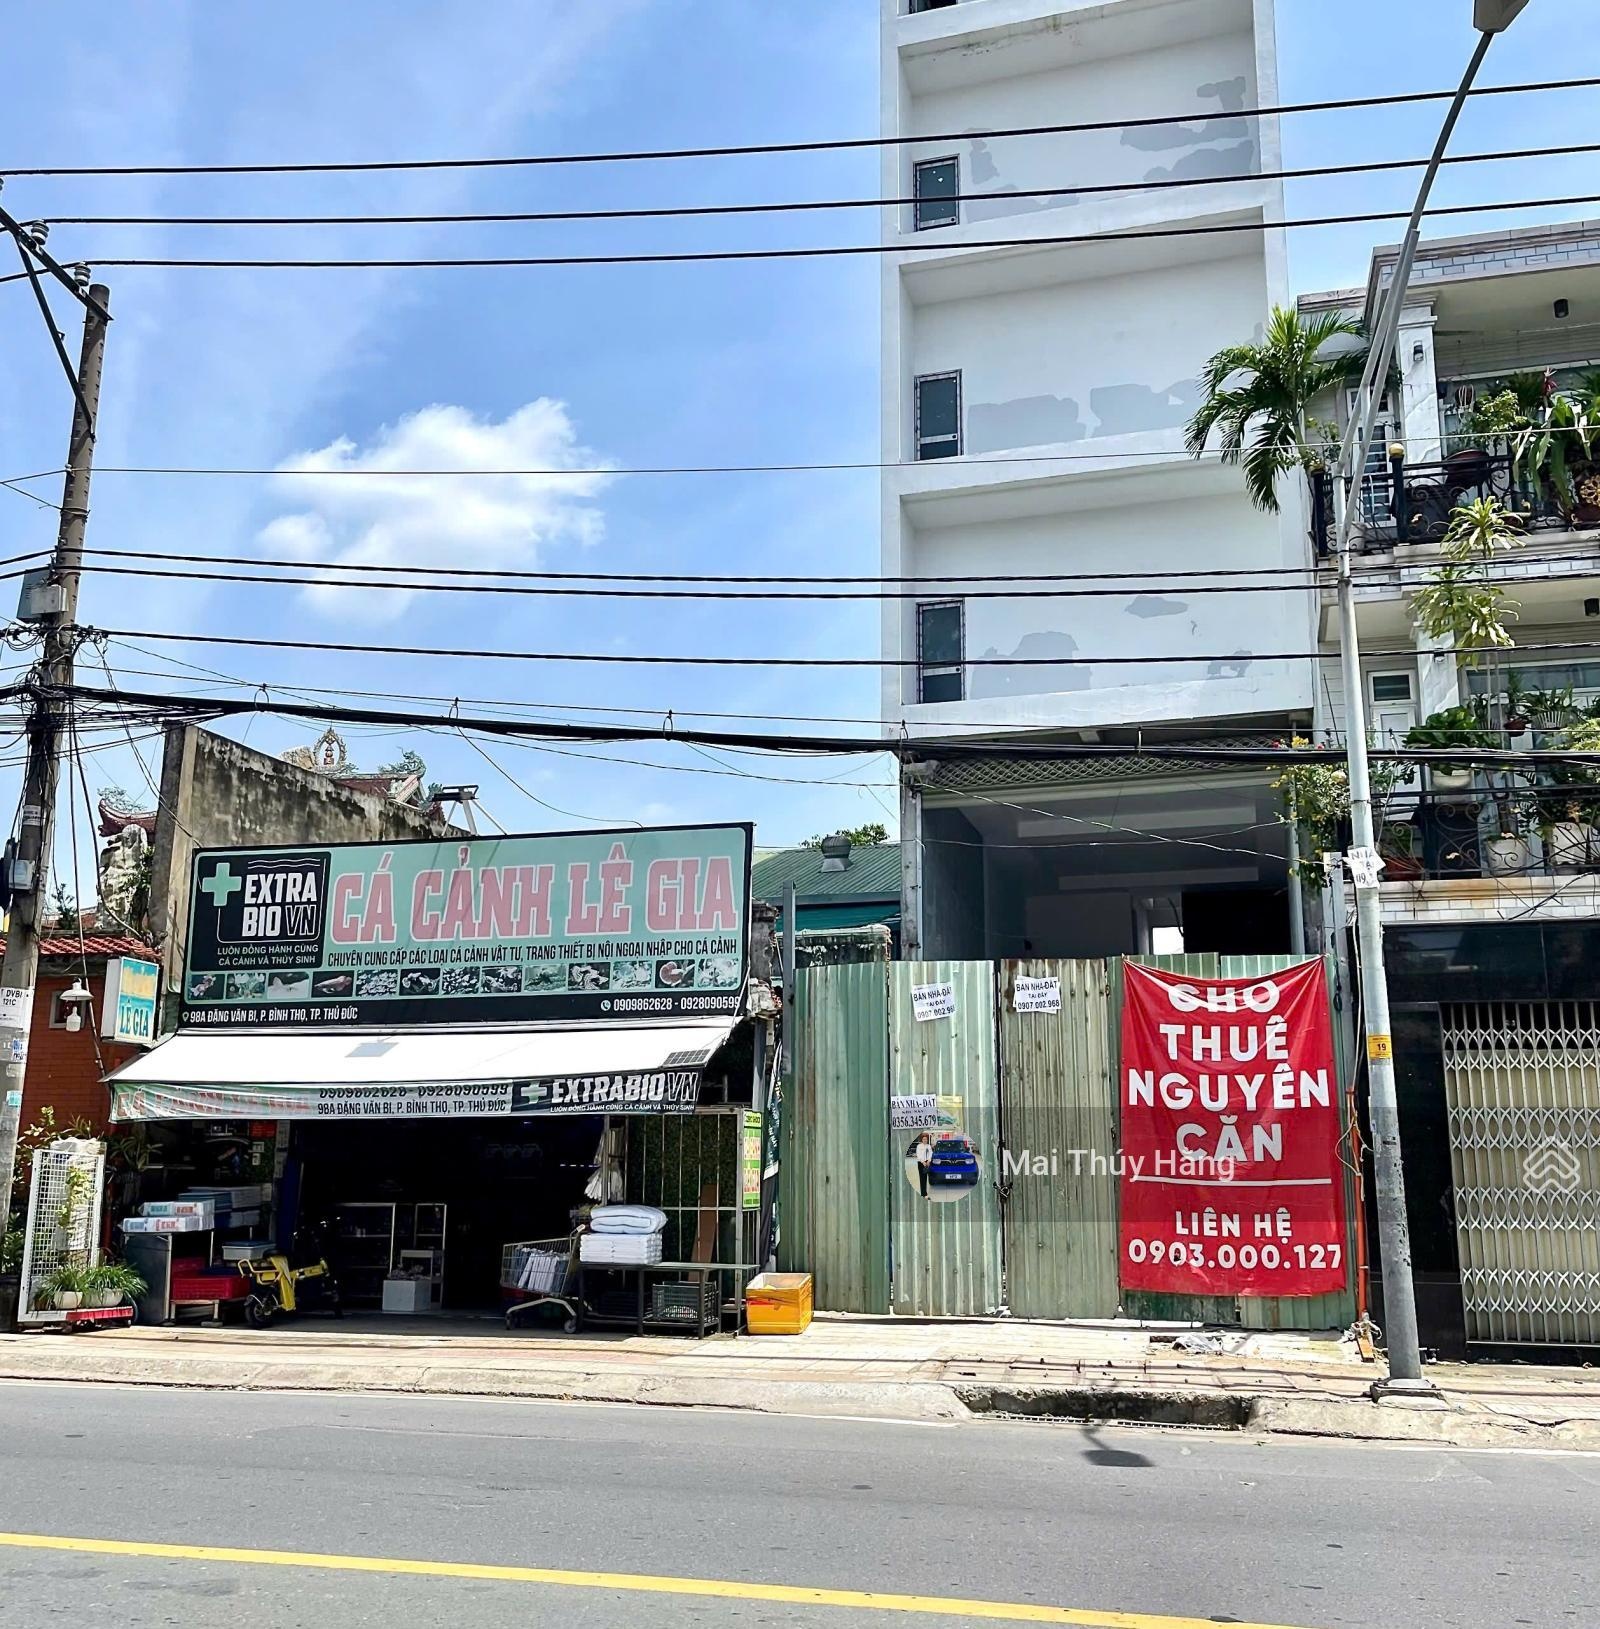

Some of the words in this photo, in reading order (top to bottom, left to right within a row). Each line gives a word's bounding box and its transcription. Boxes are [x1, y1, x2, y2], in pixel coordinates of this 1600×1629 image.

[244, 872, 317, 904] EXTRA
[330, 851, 397, 944] CÁ
[410, 845, 555, 942] CẢNH
[565, 842, 634, 936] LÊ
[646, 856, 738, 934] GIA
[295, 955, 316, 964] SINH
[327, 949, 363, 967] CHUYÊN
[364, 951, 388, 965] CUNG
[389, 946, 407, 965] CẤP
[409, 947, 427, 964] CÁC
[428, 949, 448, 966] LOẠI
[450, 946, 461, 963] CÁ
[464, 944, 489, 962] CẢNH
[491, 944, 508, 963] VẬT
[526, 945, 556, 961] TRANG
[558, 940, 584, 959] THIẾT
[586, 943, 596, 960] BỊ
[598, 940, 613, 960] NỘI
[616, 941, 644, 959] NGOẠI
[646, 938, 672, 958] NHẬP
[674, 940, 693, 955] CHO
[696, 937, 708, 954] CÁ
[711, 935, 737, 954] CẢNH
[613, 998, 672, 1011] 0909862628
[681, 996, 740, 1010] 0928090599
[1168, 979, 1280, 1013] CHO
[133, 1008, 149, 1037] GIA
[190, 1011, 206, 1022] 98A
[207, 1009, 229, 1024] ĐẶNG
[231, 1008, 247, 1022] VĂN
[260, 1010, 267, 1022] P.
[269, 1007, 288, 1021] BÌNH
[310, 1008, 321, 1020] TP.
[324, 1005, 339, 1020] THỦ
[341, 1006, 358, 1019] ĐỨC
[1159, 1015, 1288, 1061] THUÊ
[1128, 1062, 1330, 1111] NGUYÊN
[317, 1102, 335, 1114] 98A
[363, 1100, 380, 1114] VĂN
[397, 1102, 404, 1113] P.
[453, 1100, 465, 1112] TP.
[469, 1097, 485, 1112] THỦ
[892, 1114, 937, 1128] 0356.345.679
[1176, 1115, 1283, 1162] CĂN
[1175, 1206, 1241, 1238] LIÊN
[1254, 1207, 1292, 1244] HỆ
[1128, 1239, 1341, 1269] 0903.000.127
